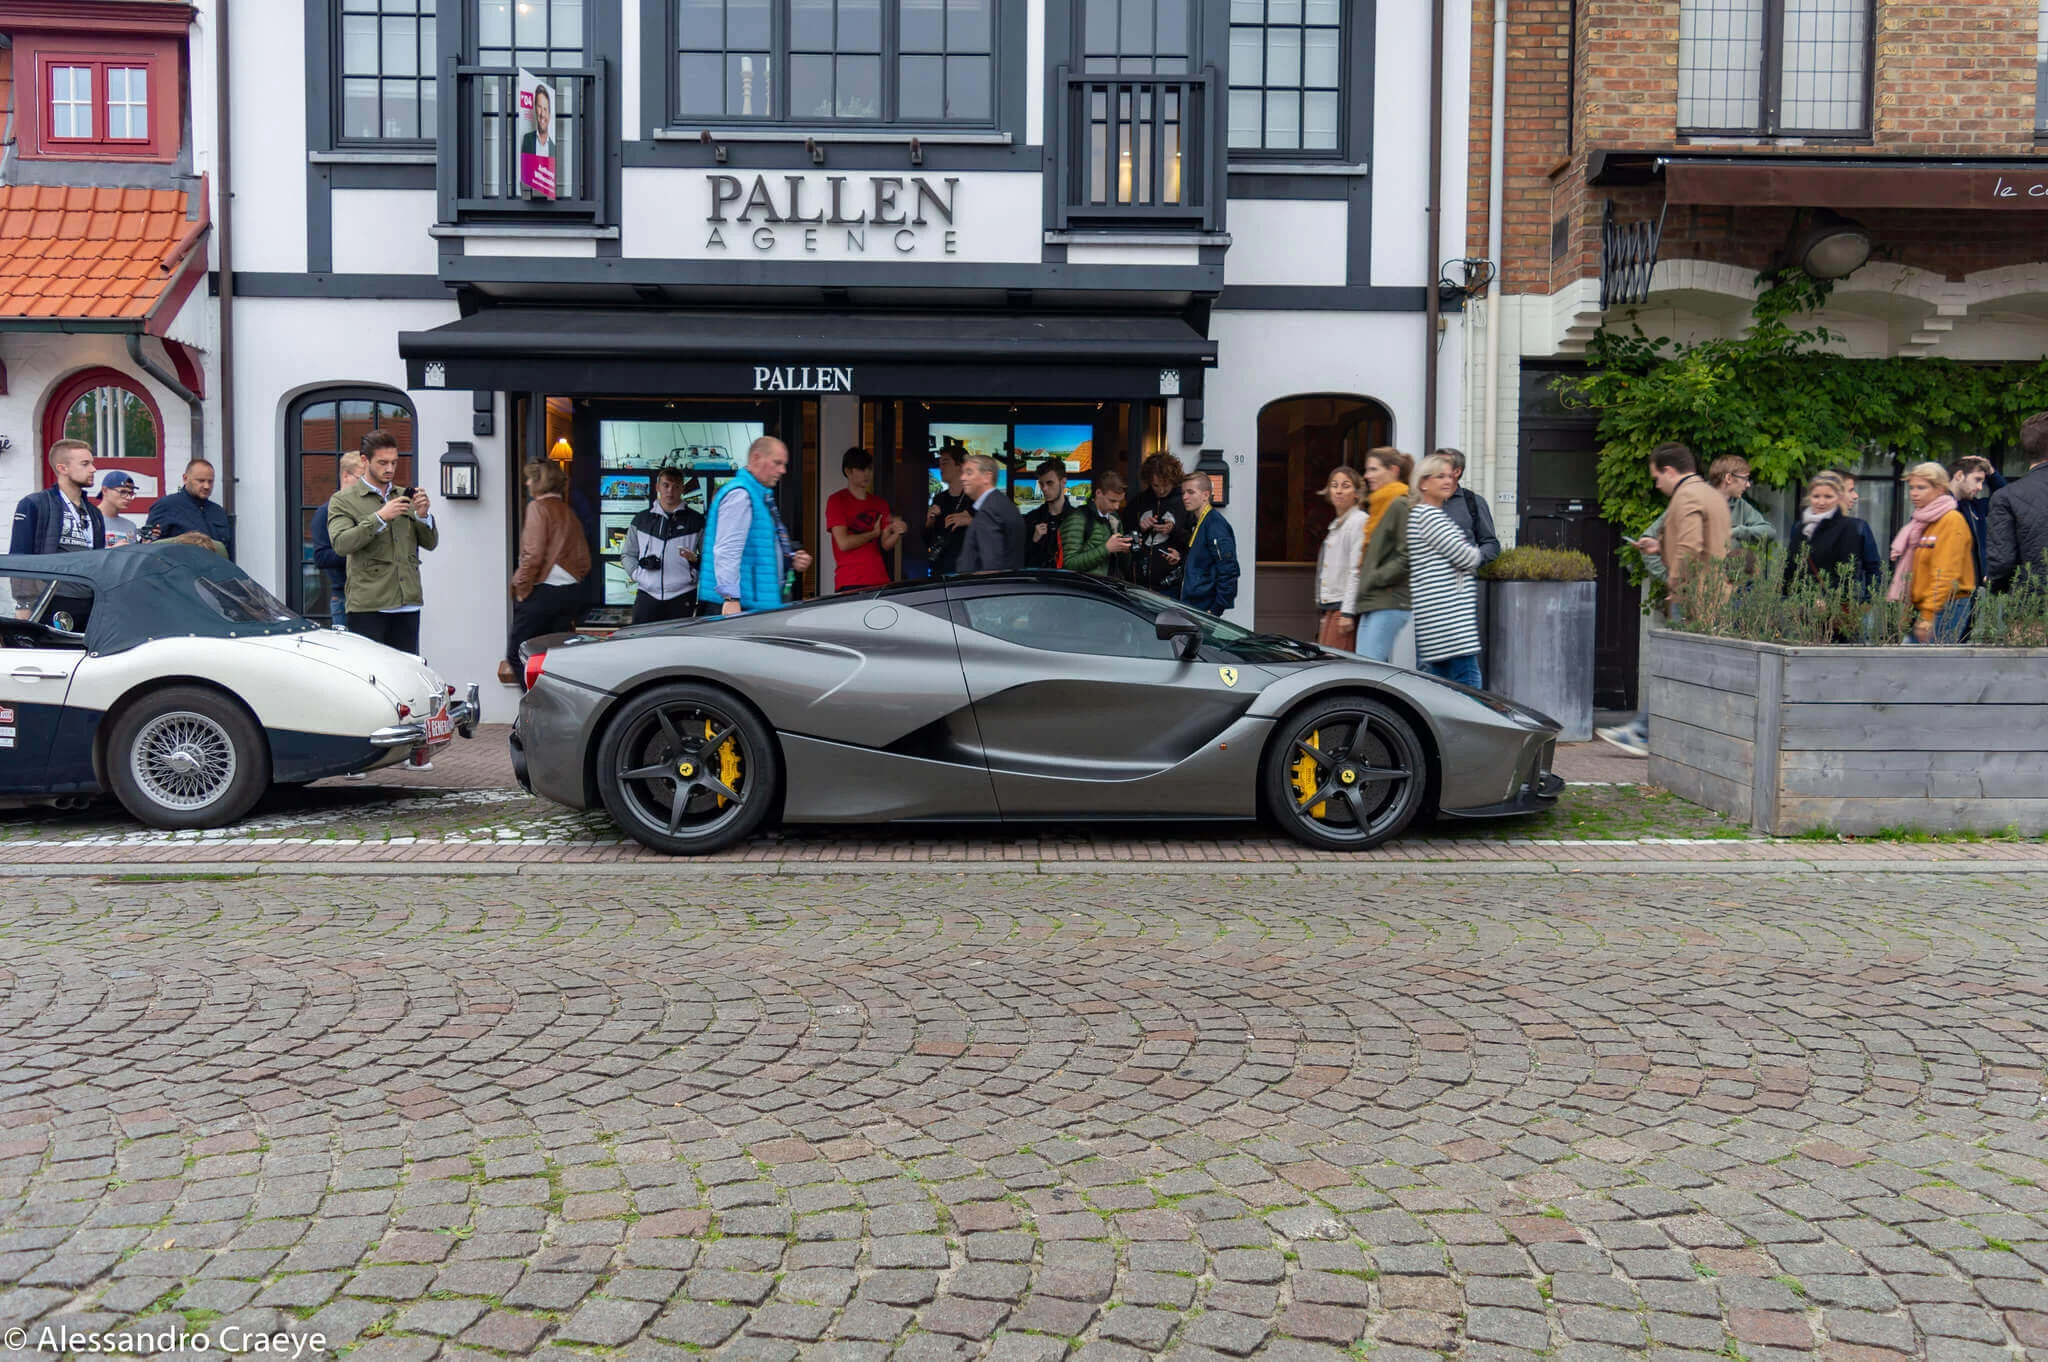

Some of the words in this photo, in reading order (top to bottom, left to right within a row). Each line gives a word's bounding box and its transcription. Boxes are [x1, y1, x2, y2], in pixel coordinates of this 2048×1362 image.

[1993, 176, 2018, 197] le
[706, 174, 960, 226] PALLEN
[705, 226, 957, 254] AGENCE
[753, 366, 854, 392] PALLEN
[1234, 454, 1245, 464] 90
